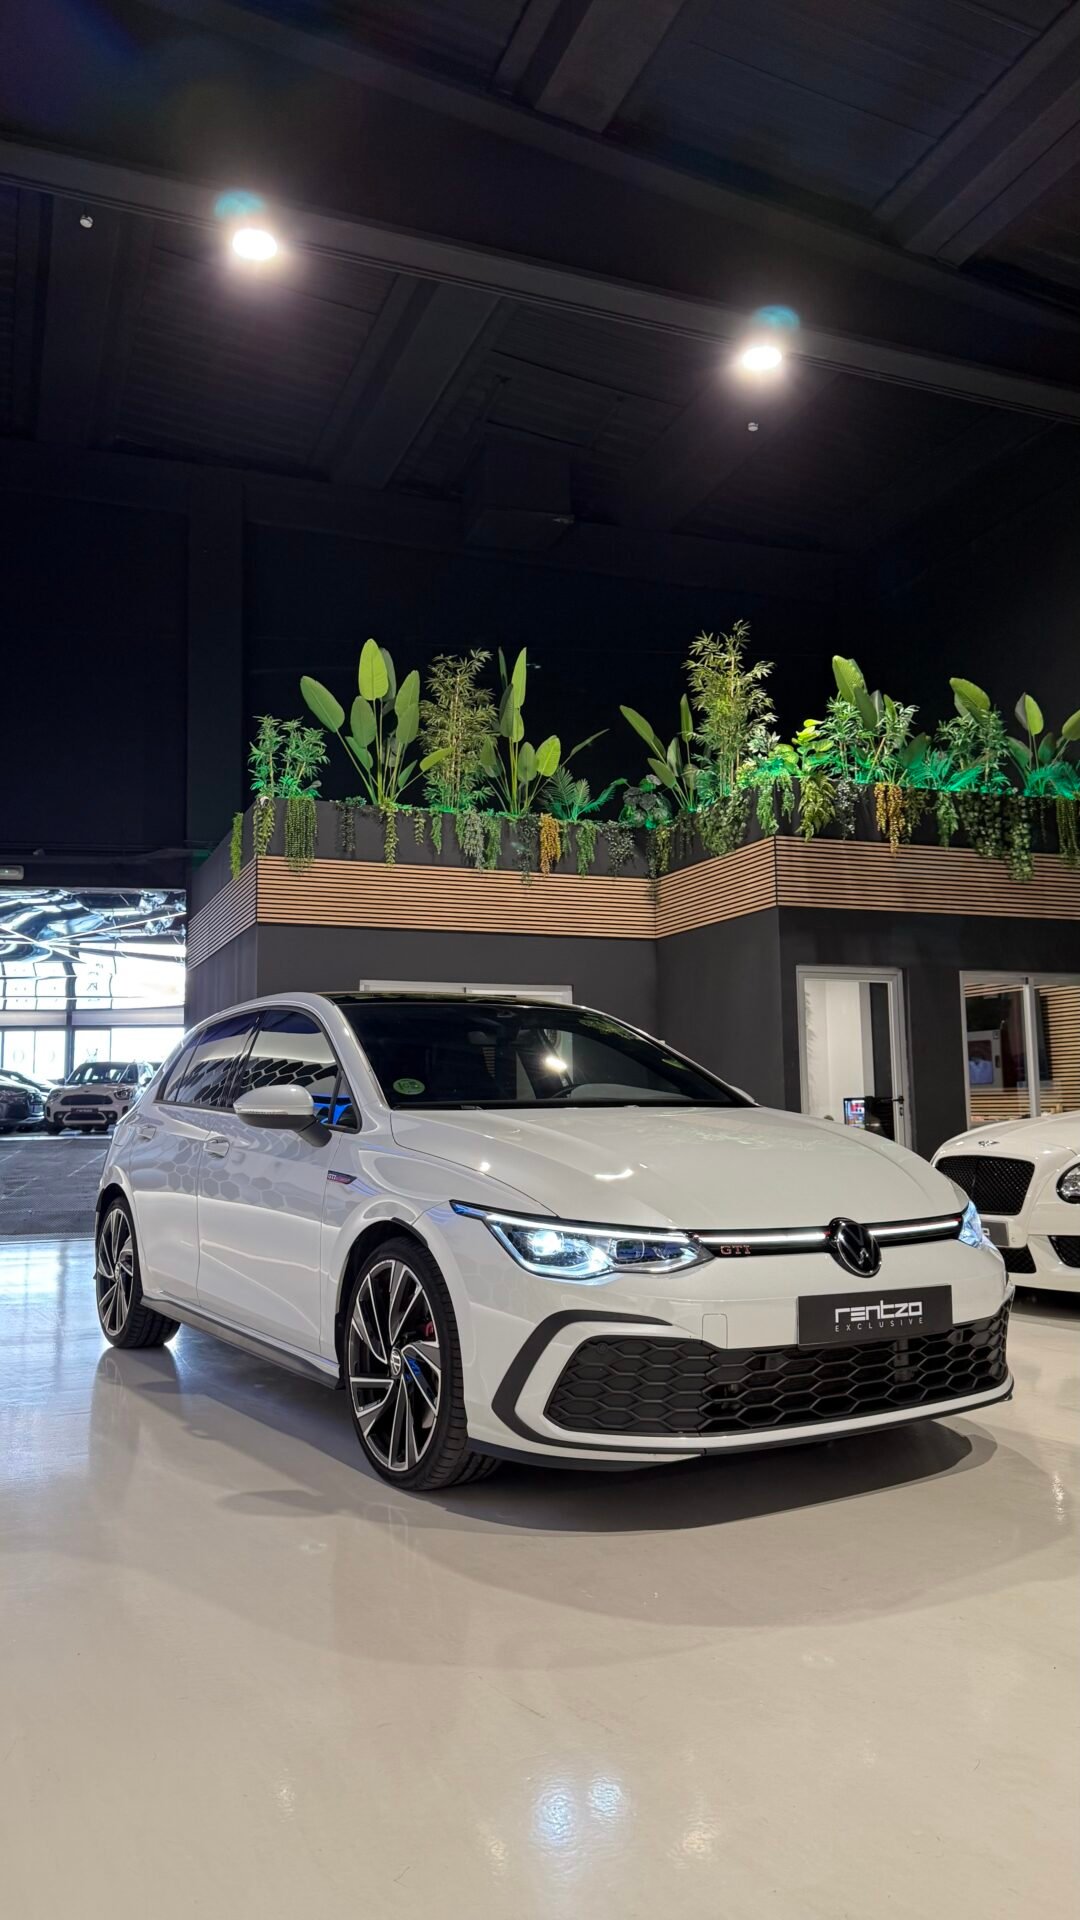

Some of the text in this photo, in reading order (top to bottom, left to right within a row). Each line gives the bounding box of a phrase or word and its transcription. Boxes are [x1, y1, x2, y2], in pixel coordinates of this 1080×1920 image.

[720, 1245, 751, 1255] GTI
[835, 1300, 923, 1323] rentzo
[835, 1317, 923, 1332] EXCLUSIVE
